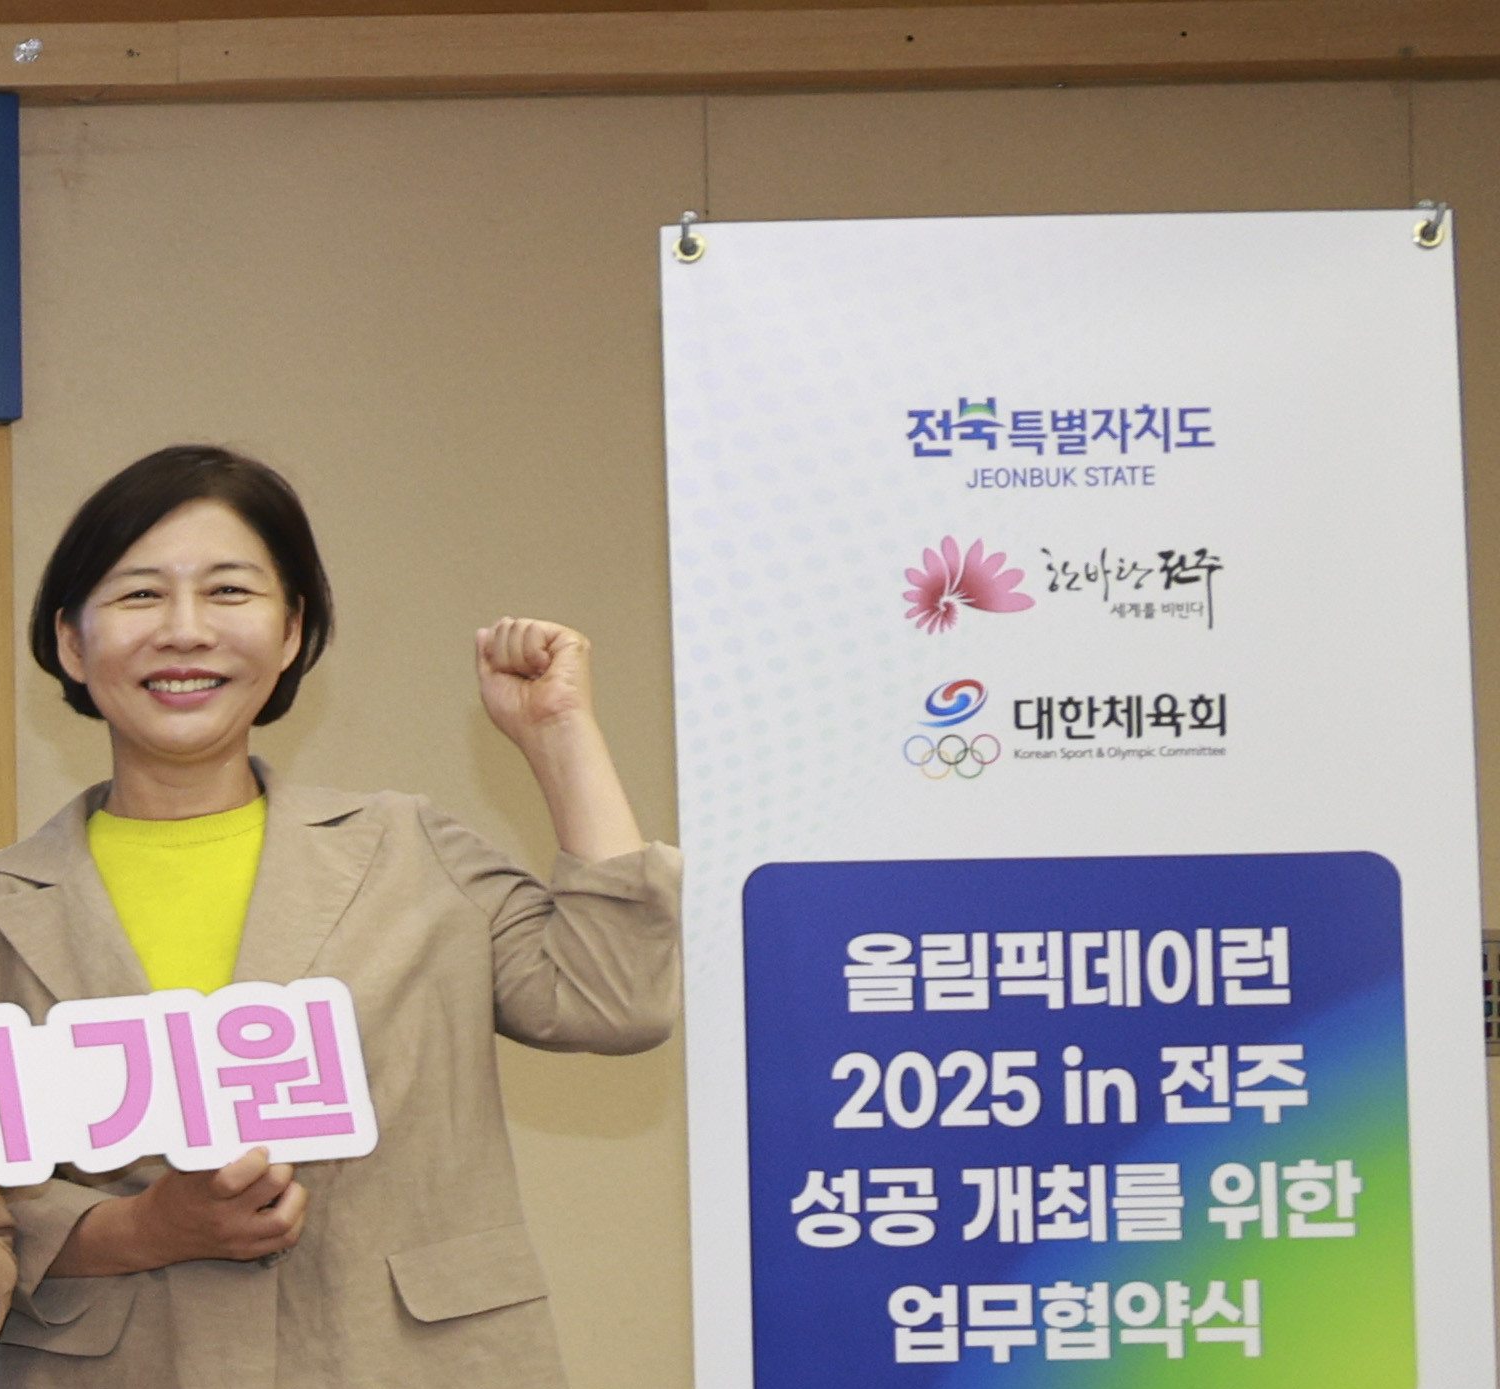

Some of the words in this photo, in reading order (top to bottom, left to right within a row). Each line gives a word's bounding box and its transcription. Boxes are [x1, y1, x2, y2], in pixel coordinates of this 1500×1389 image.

[905, 396, 1216, 458] 전북특별자치도
[965, 466, 1078, 489] JEONBUK
[1084, 465, 1155, 488] STATE
[1110, 601, 1156, 620] 세계를
[1160, 601, 1205, 620] 비빈다
[1157, 547, 1224, 630] 전주
[1013, 693, 1227, 740] 대한체육회
[1013, 748, 1058, 760] Korean
[1059, 747, 1094, 761] Sport
[1106, 746, 1156, 761] Olympic
[1158, 745, 1227, 758] Committee
[843, 926, 1291, 1013] 올림픽데이런
[71, 1001, 358, 1149] 기원
[831, 1050, 1041, 1129] 2025
[1062, 1045, 1137, 1125] in
[1161, 1044, 1309, 1124] 전주
[791, 1167, 938, 1248] 성공
[961, 1162, 1185, 1244] 개최를
[1208, 1159, 1362, 1240] 위한
[888, 1277, 1266, 1365] 업무협약식
